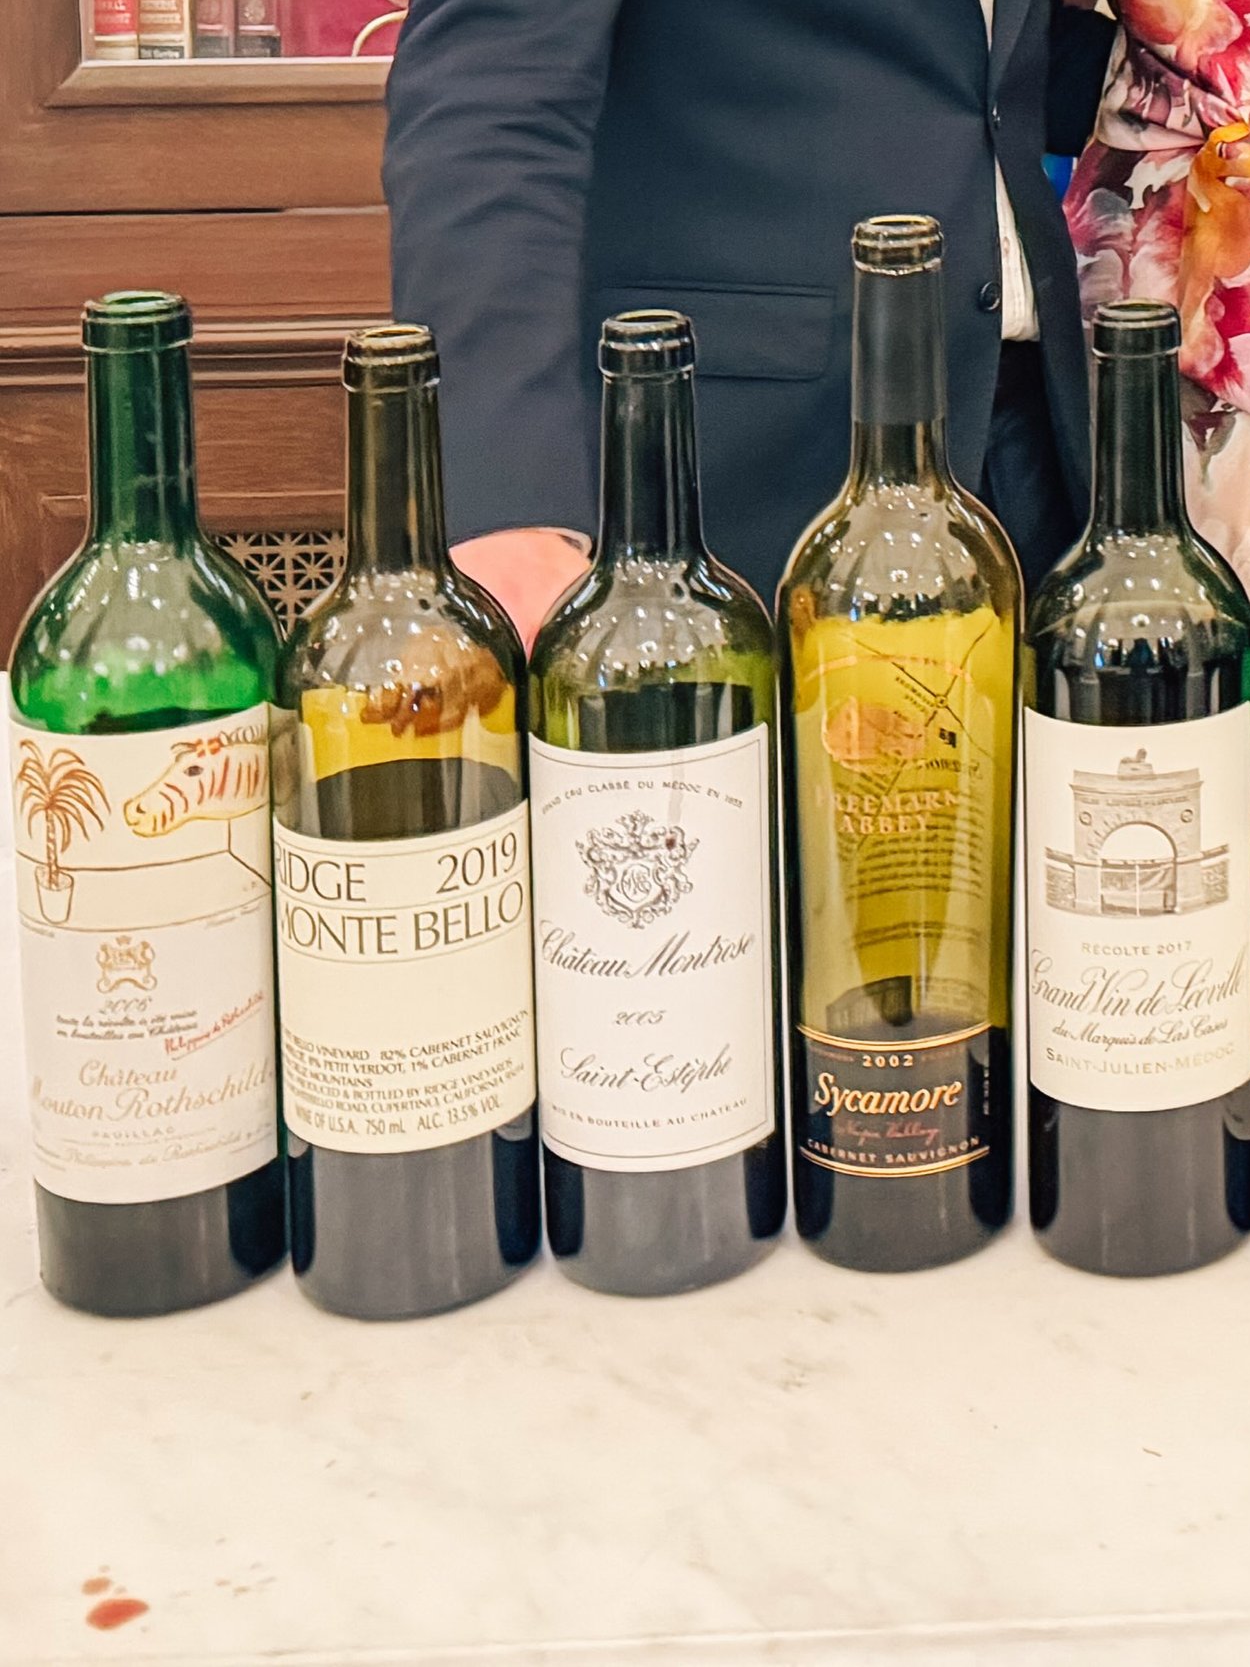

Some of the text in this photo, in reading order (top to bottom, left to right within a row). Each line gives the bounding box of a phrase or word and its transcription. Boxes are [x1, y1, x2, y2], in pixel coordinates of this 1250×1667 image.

[588, 780, 630, 794] CLASSÉ
[637, 780, 654, 789] DU
[706, 788, 720, 799] EN
[435, 831, 518, 894] 2019
[413, 880, 524, 951] BELLO
[540, 919, 755, 979] Château Montrose
[1156, 940, 1193, 955] 2017
[1031, 949, 1097, 1013] Grand
[1081, 966, 1149, 1017] Vin
[316, 1045, 370, 1061] VINEYARD
[409, 1035, 471, 1058] CABERNET
[431, 1042, 490, 1069] CABERNET
[861, 1054, 915, 1068] 2002
[107, 1056, 270, 1121] Rothschild
[310, 1071, 373, 1089] MOUNTAINS
[814, 1071, 964, 1118] Sycamore
[314, 1112, 326, 1129] OF
[365, 1118, 386, 1135] 750
[587, 1117, 661, 1129] BOUTEILLE
[666, 1116, 685, 1126] AU
[806, 1135, 981, 1165] CABERNET SAUVIGNON
